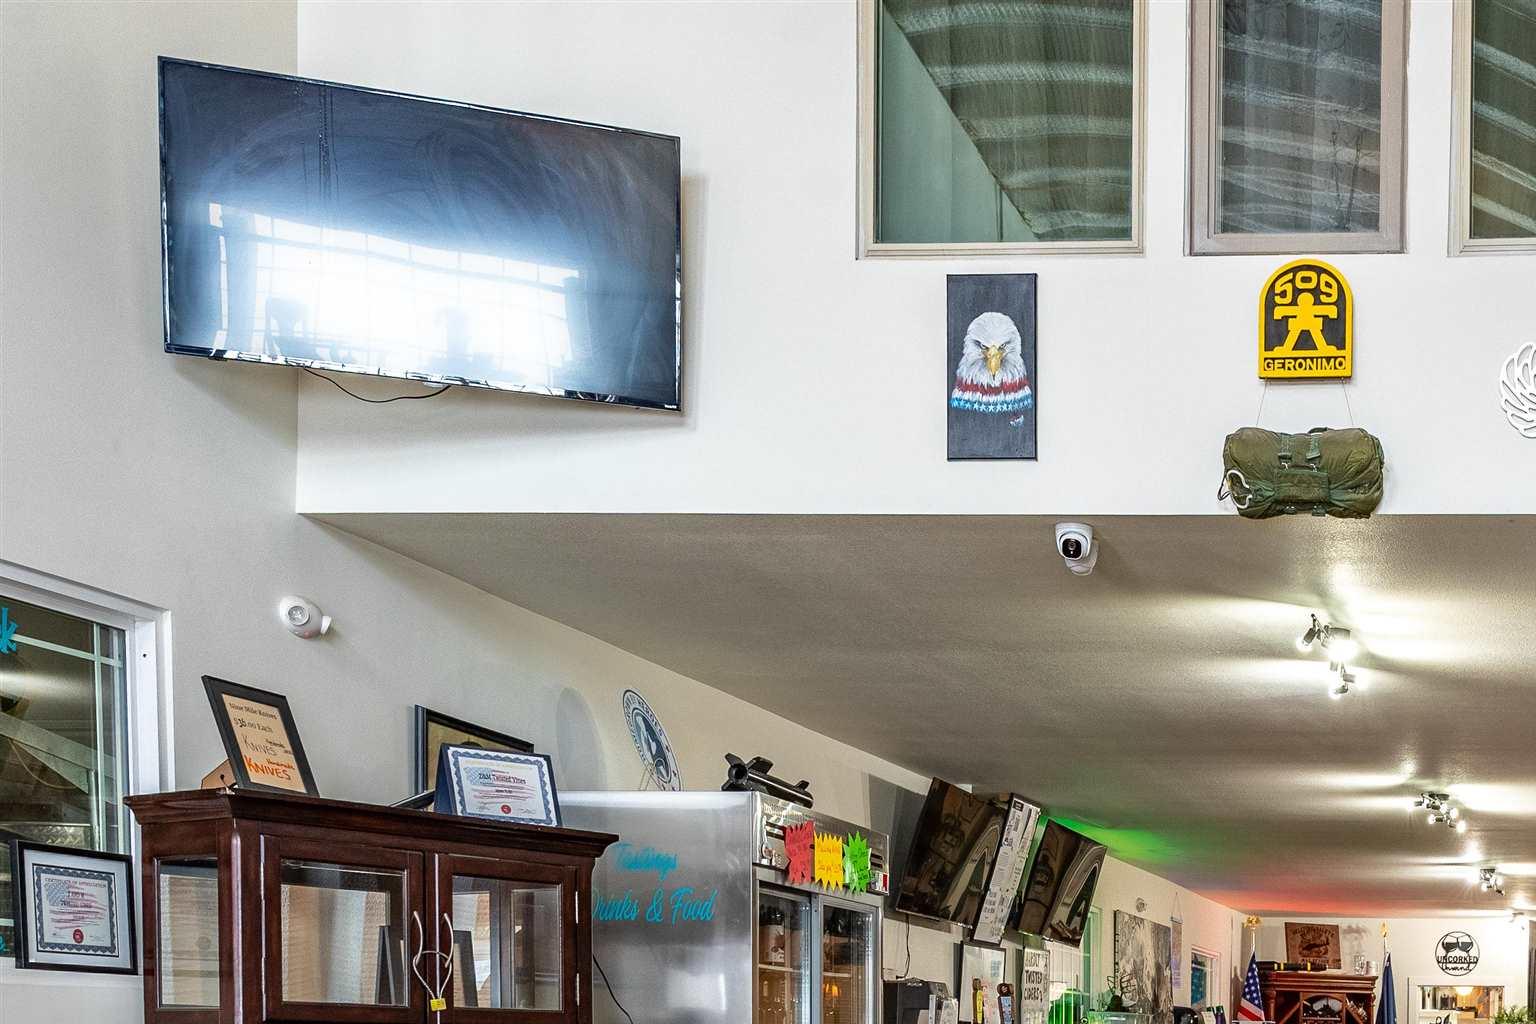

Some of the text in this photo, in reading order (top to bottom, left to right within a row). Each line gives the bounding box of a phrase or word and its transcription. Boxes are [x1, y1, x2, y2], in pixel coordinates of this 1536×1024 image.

[1274, 270, 1338, 304] 509
[1264, 358, 1346, 371] GERONIMO
[244, 754, 291, 780] KNIVES
[646, 888, 664, 922] &
[670, 886, 718, 927] Food
[1437, 955, 1478, 963] UNCORKED
